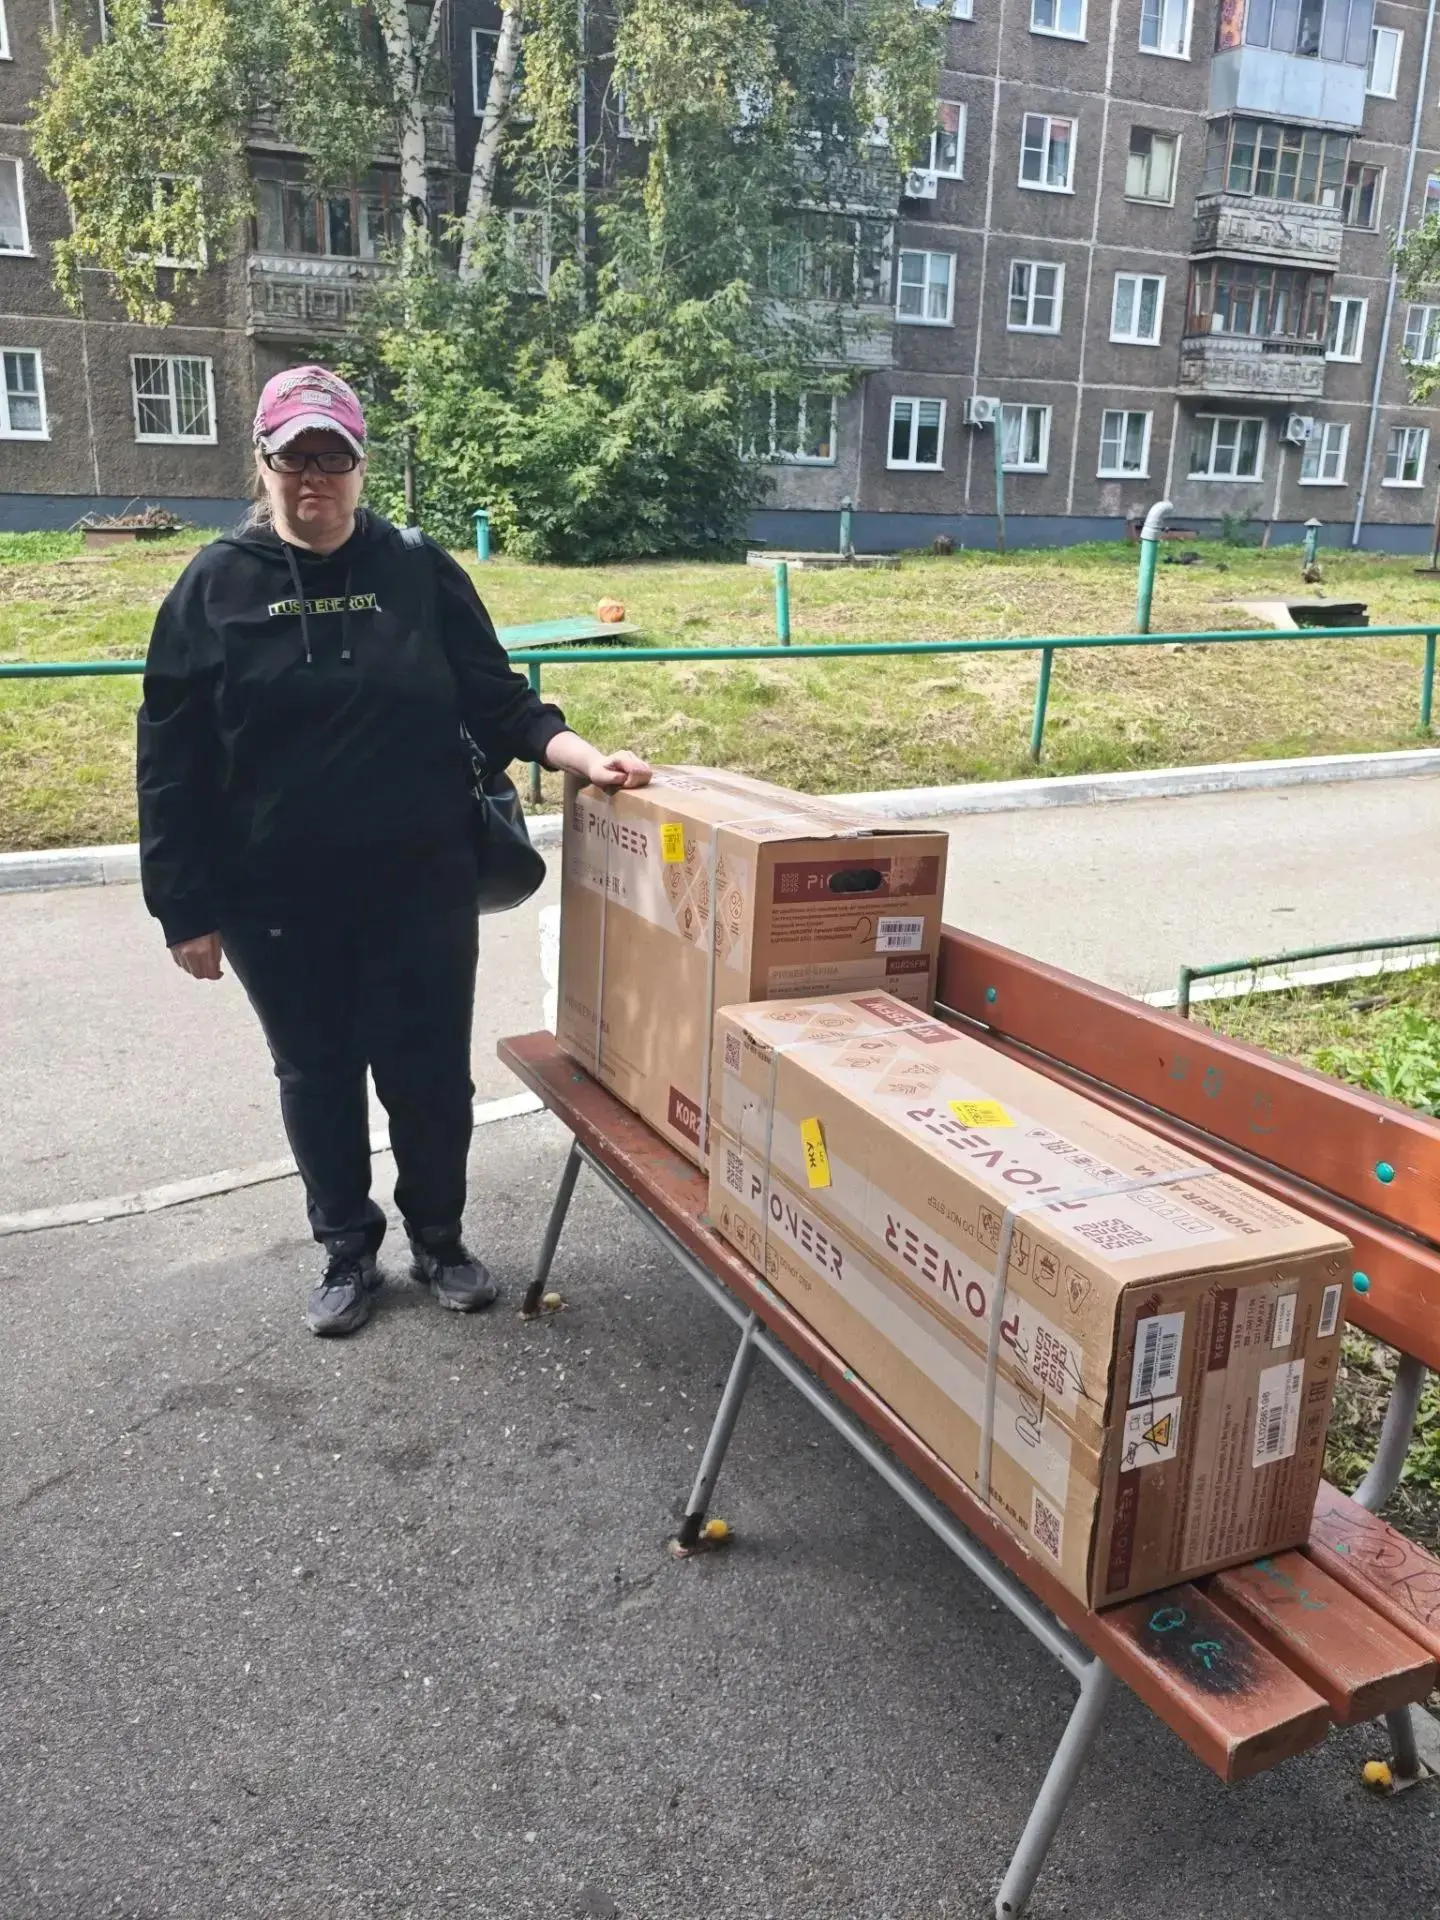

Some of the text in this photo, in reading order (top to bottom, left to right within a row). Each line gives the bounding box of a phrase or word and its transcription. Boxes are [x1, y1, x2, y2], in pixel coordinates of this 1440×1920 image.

[588, 812, 648, 858] PIONEER
[751, 1174, 843, 1281] PONEER
[1181, 1191, 1262, 1235] PIONEER
[885, 1213, 1020, 1350] PONEER
